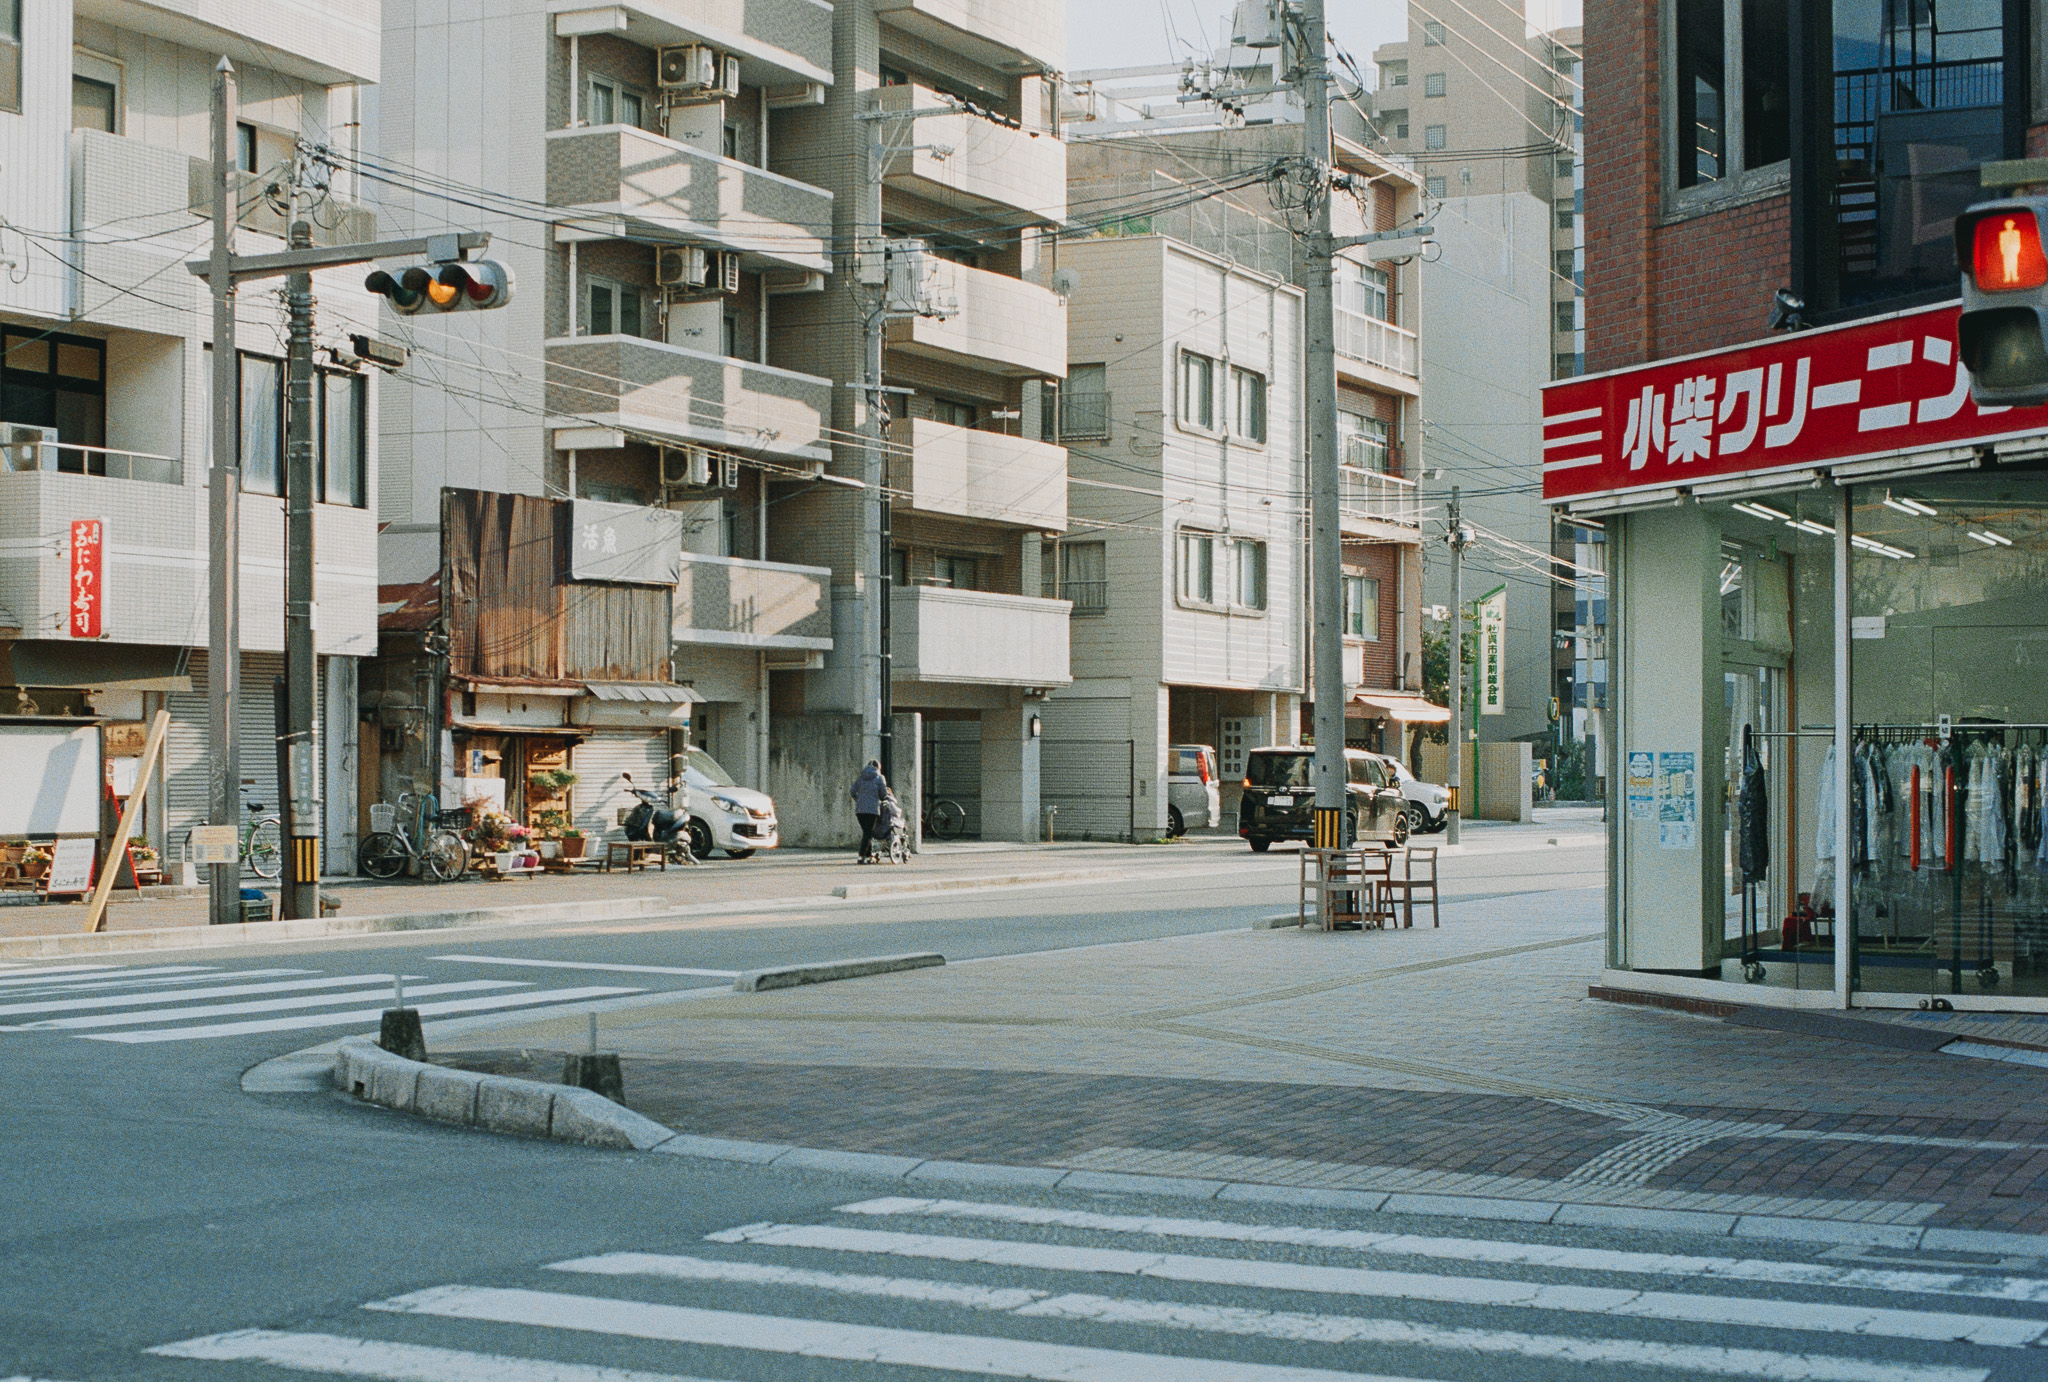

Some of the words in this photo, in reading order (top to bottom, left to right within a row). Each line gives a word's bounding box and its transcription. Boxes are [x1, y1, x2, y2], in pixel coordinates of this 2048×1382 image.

[1622, 335, 2013, 471] 小柴クリーニン
[74, 523, 94, 634] なにわ寿司
[582, 524, 617, 554] 活魚
